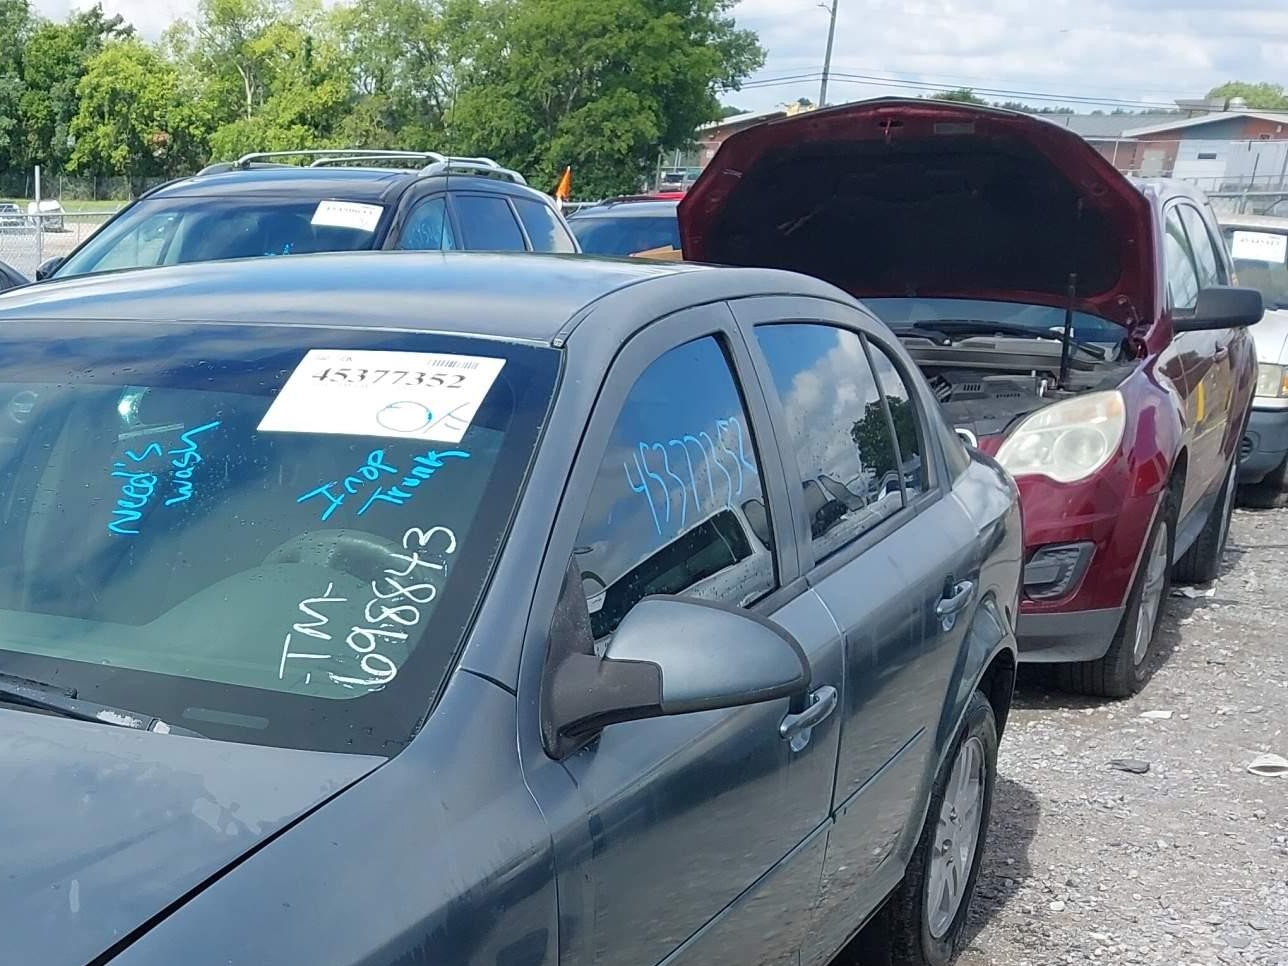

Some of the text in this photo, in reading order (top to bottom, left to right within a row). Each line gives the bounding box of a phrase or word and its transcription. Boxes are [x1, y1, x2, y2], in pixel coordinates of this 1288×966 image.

[312, 367, 467, 389] 45377352
[623, 416, 758, 536] 45377352
[327, 526, 458, 692] 698843
